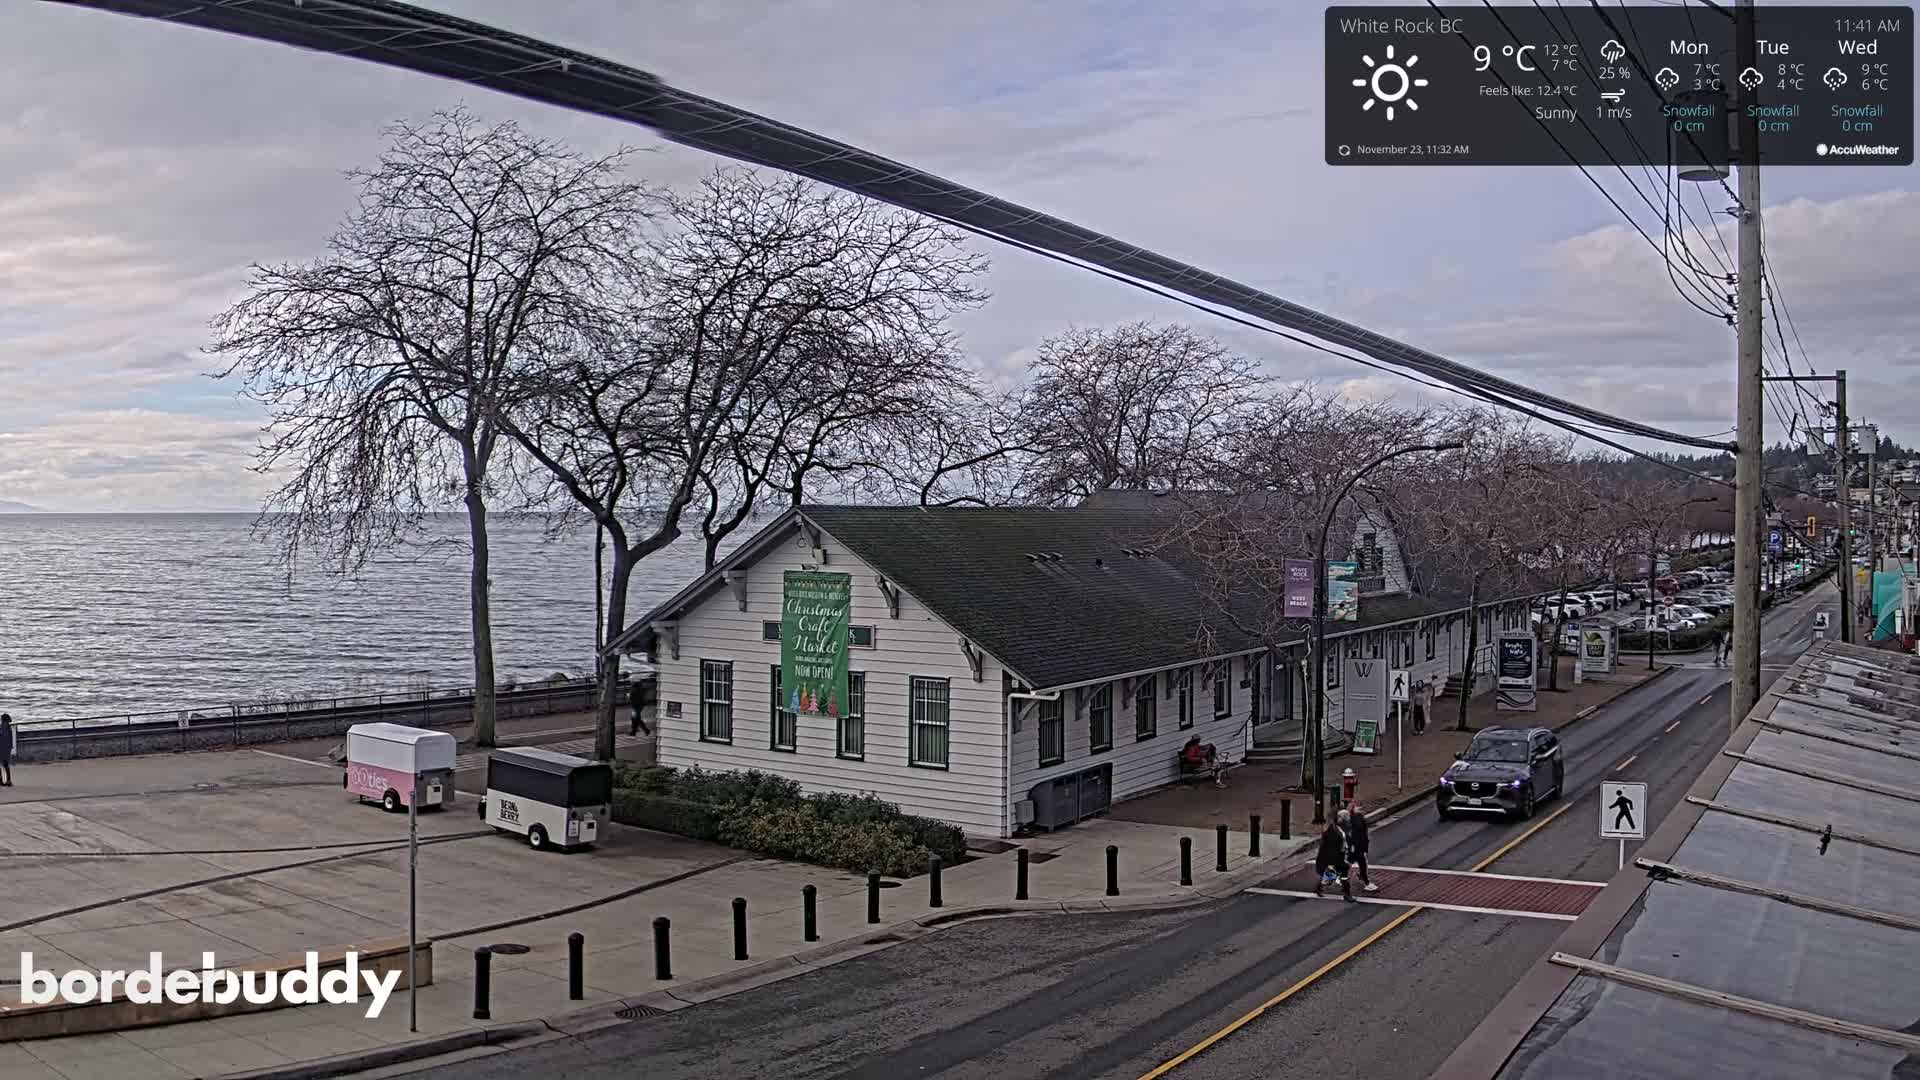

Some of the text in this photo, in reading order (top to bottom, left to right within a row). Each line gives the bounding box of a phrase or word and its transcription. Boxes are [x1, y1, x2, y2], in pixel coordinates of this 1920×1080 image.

[787, 599, 842, 617] Christmas
[799, 615, 829, 642] Craft
[792, 634, 838, 654] Market
[795, 664, 834, 680] NOW OPEN!
